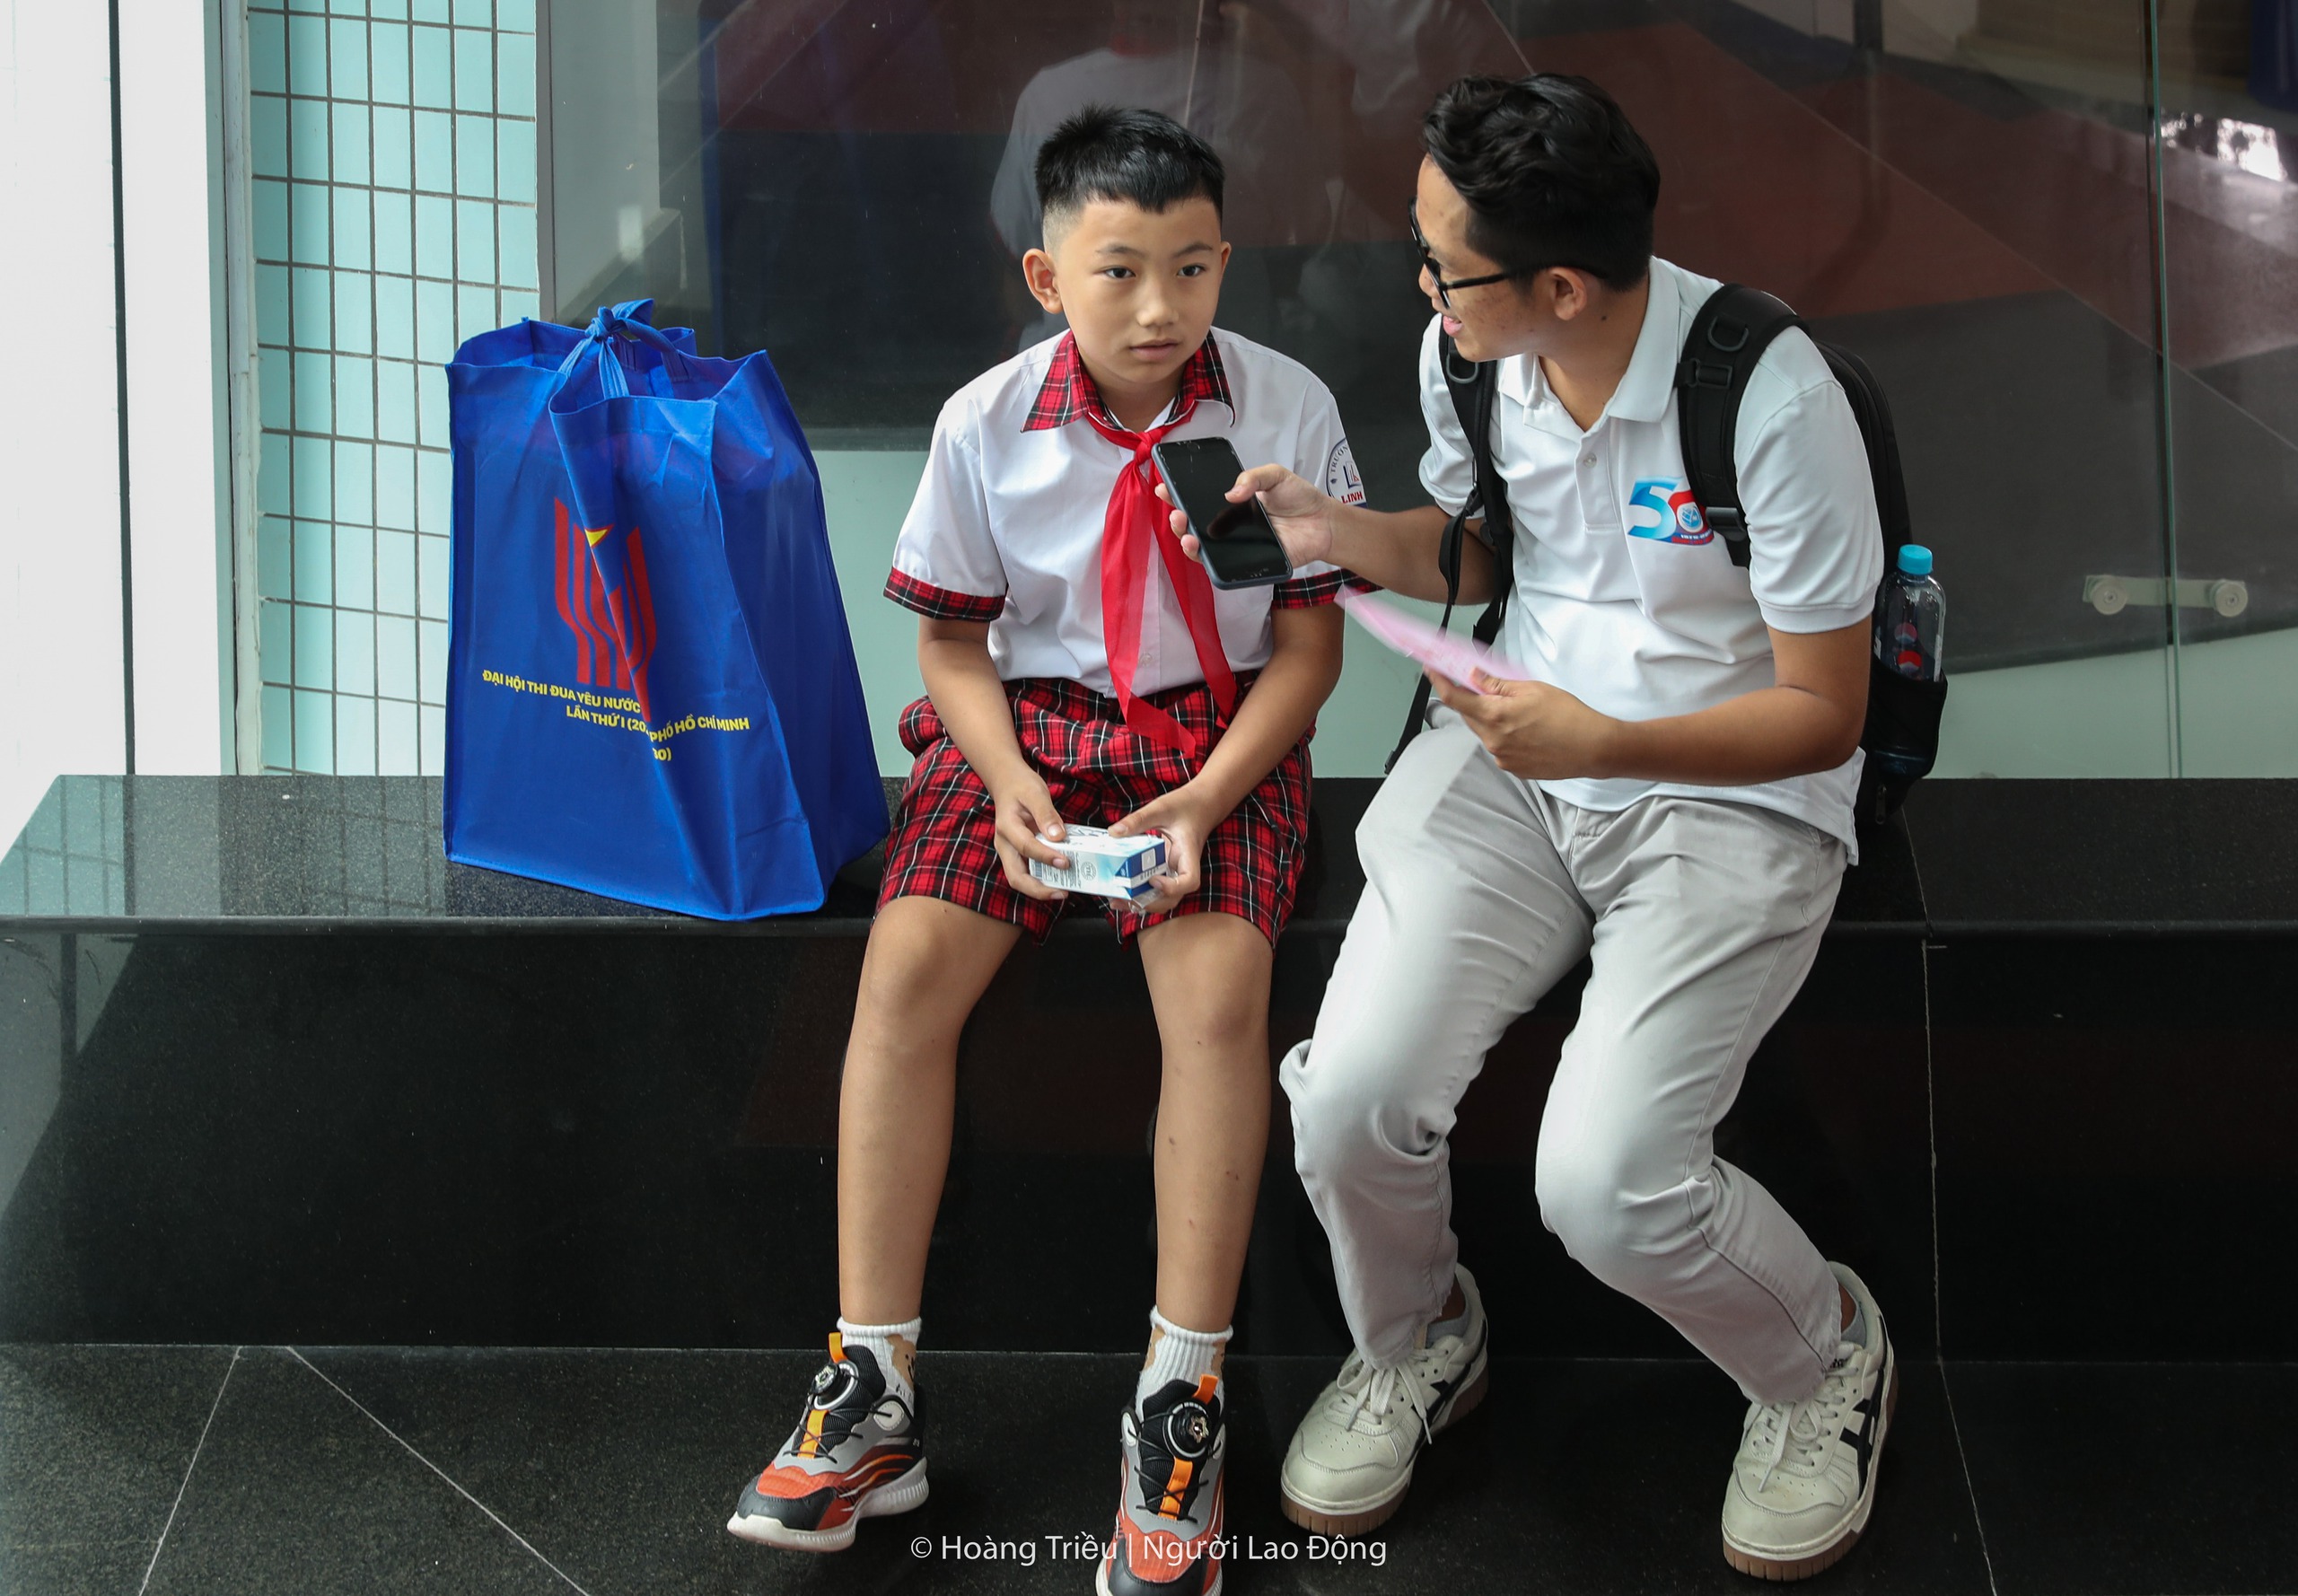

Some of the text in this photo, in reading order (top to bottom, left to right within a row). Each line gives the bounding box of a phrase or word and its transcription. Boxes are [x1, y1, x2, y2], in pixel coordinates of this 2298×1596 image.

[1341, 491, 1364, 504] LINH
[482, 670, 750, 743] ĐẠI HỘI THI ĐUA YÊU NƯỚC PHỐ HỒ CHÍ MINH
[566, 705, 591, 722] LẦN
[591, 712, 620, 728] THỨ
[620, 716, 626, 729] I
